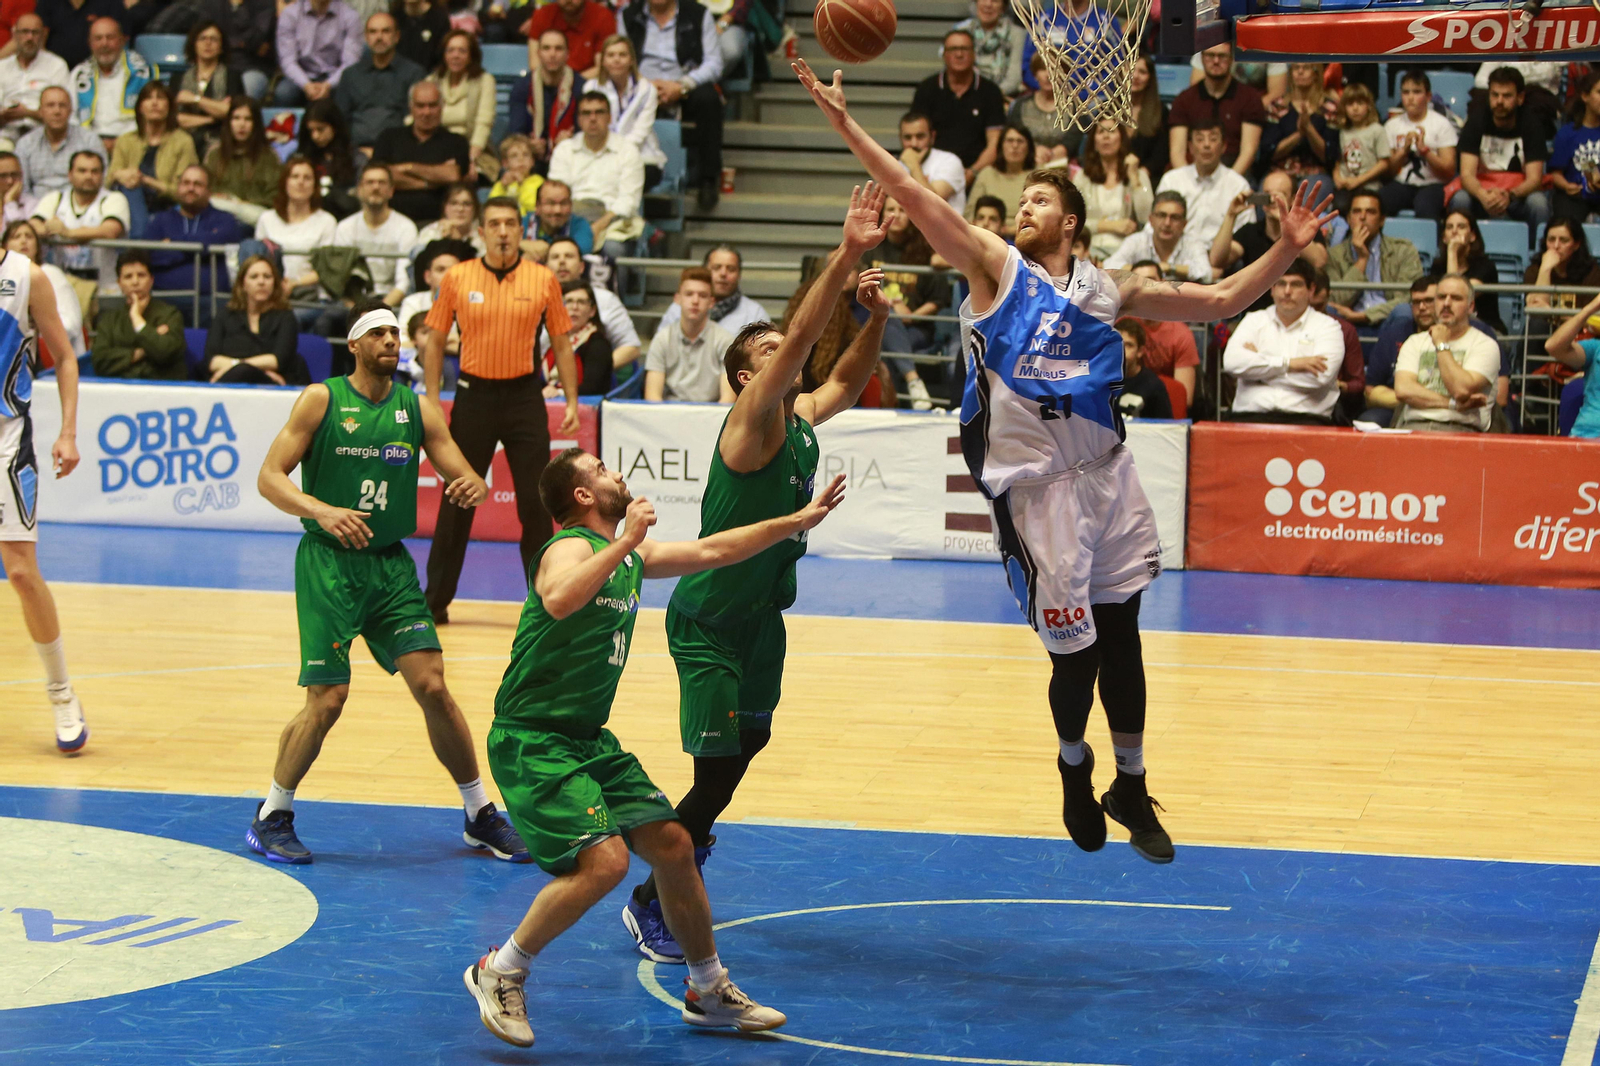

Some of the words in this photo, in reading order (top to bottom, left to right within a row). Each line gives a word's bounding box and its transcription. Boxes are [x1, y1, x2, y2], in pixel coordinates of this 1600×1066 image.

[1381, 10, 1600, 54] SPORTIU
[1029, 338, 1071, 356] Naura
[1036, 393, 1072, 420] 21
[98, 402, 236, 456] OBRA
[98, 444, 239, 492] DOIRO
[335, 445, 380, 459] energía
[385, 447, 408, 460] plus
[173, 482, 240, 515] CAB
[358, 479, 388, 511] 24
[1300, 488, 1446, 523] cenor
[1572, 481, 1600, 515] S
[1264, 520, 1444, 546] electrodomésticos
[1043, 607, 1085, 629] Rio
[1048, 621, 1089, 640] Natura
